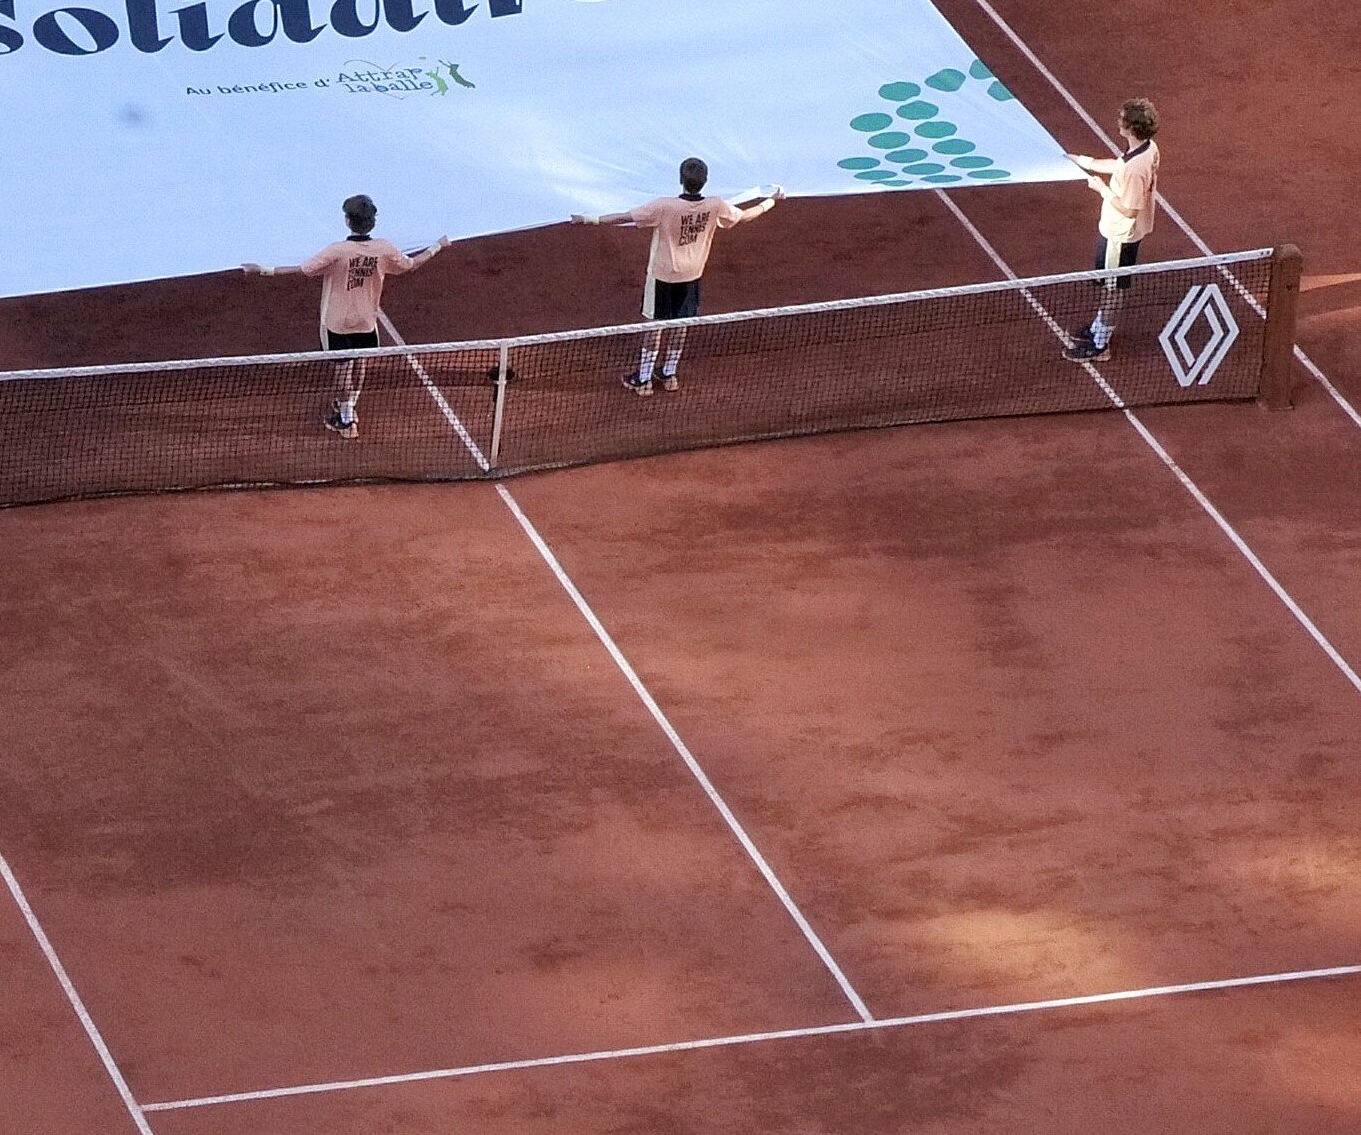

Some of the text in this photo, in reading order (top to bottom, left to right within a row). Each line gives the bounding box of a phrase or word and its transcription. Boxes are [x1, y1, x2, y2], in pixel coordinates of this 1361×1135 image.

[186, 86, 211, 96] Au
[217, 80, 308, 95] bénéfice
[681, 211, 711, 226] WE ARE
[348, 256, 379, 269] WE ARE
